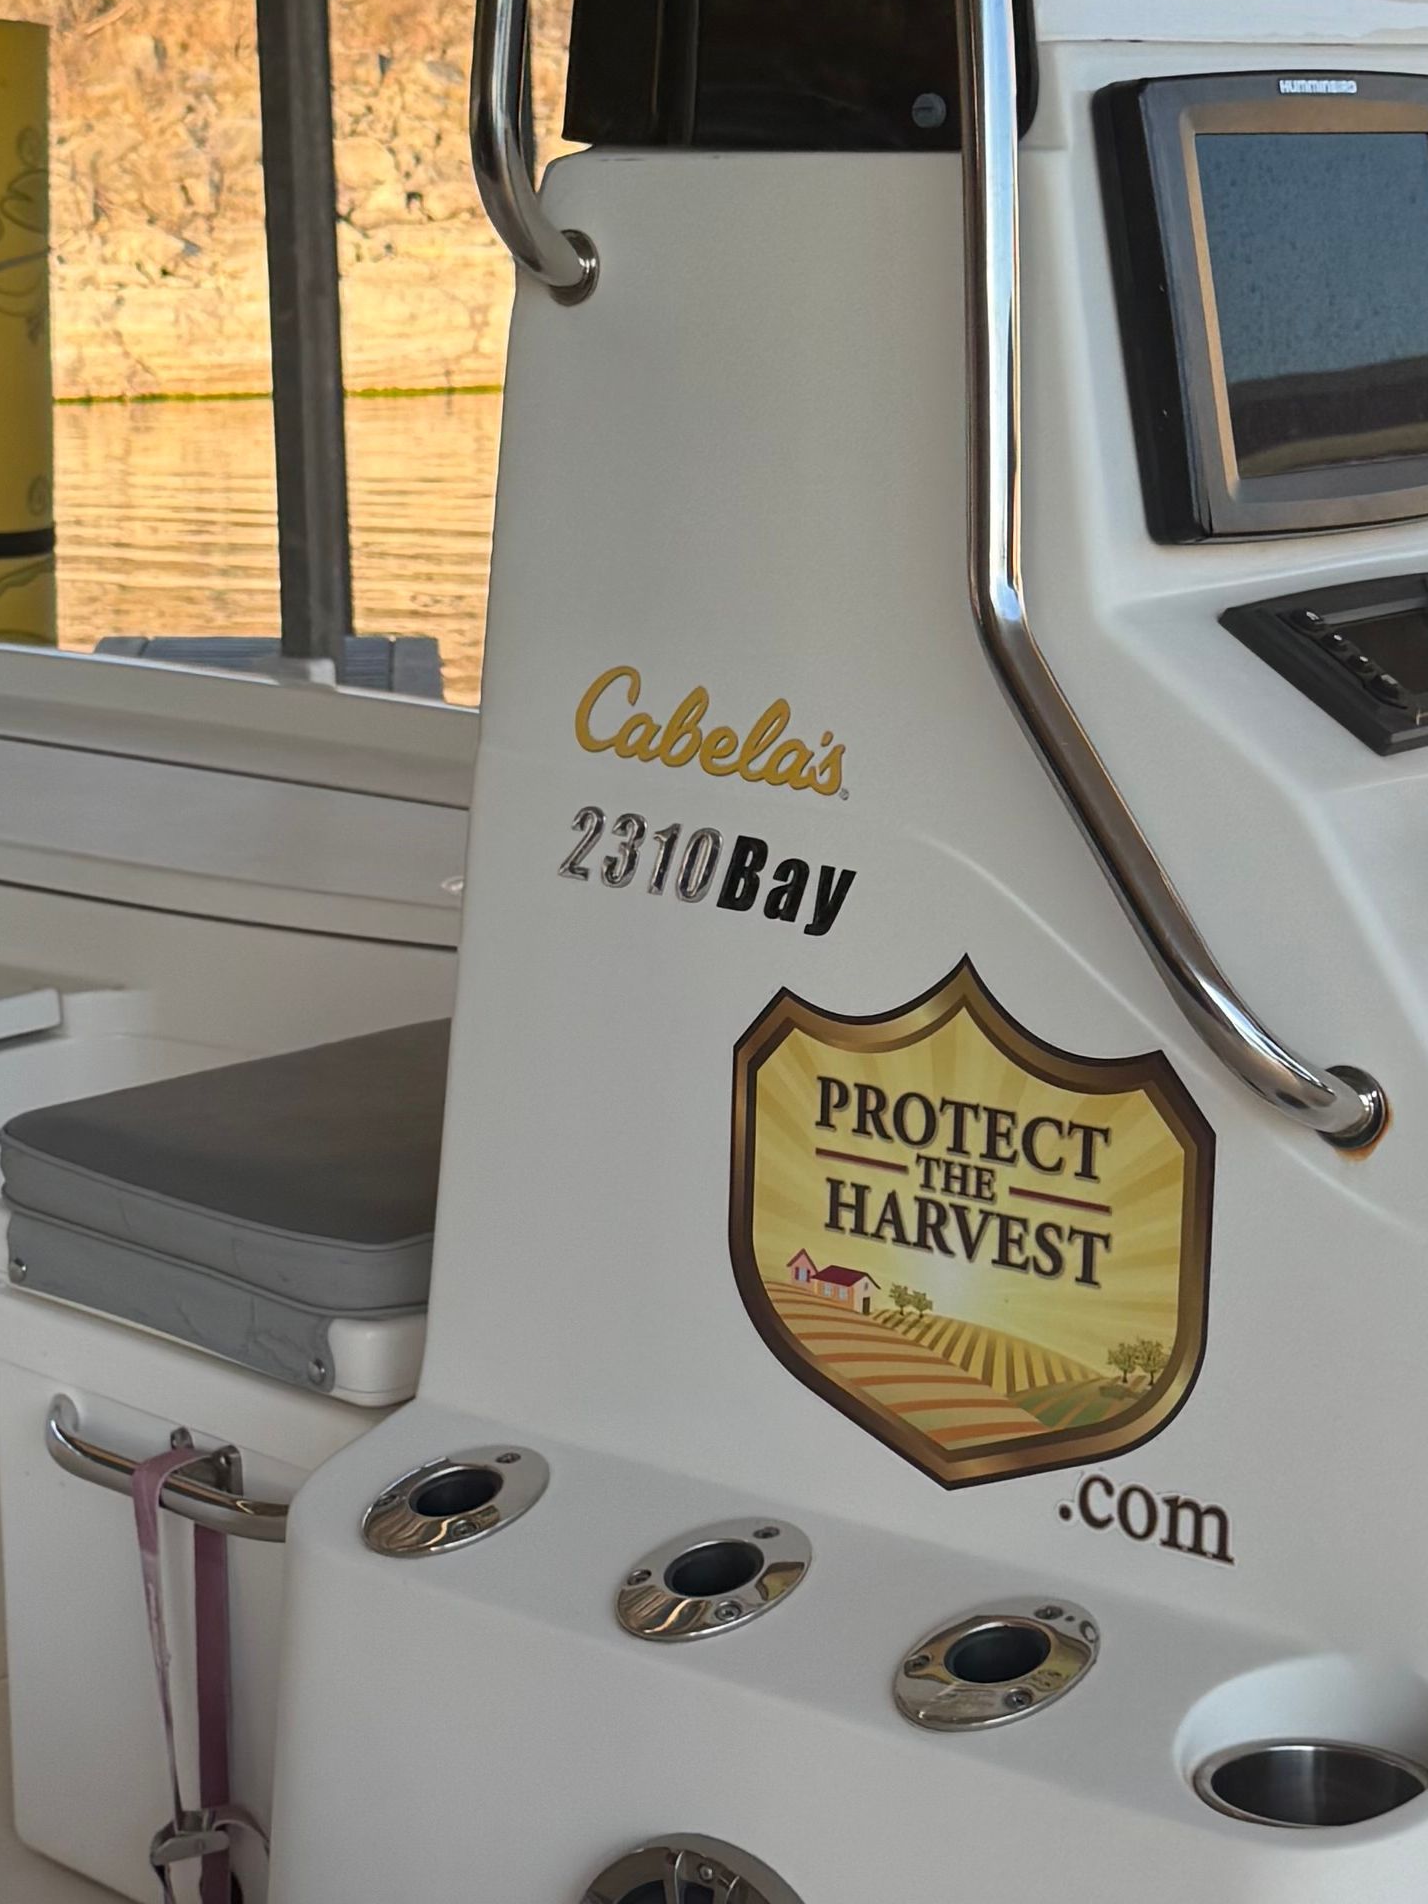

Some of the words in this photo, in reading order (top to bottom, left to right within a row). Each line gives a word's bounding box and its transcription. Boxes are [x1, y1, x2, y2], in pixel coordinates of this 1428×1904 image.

[574, 664, 848, 798] Cabela's
[815, 1074, 1113, 1183] PROTECT
[915, 1151, 998, 1205] THE
[823, 1176, 1113, 1291] HARVEST
[1056, 1469, 1236, 1567] .com
